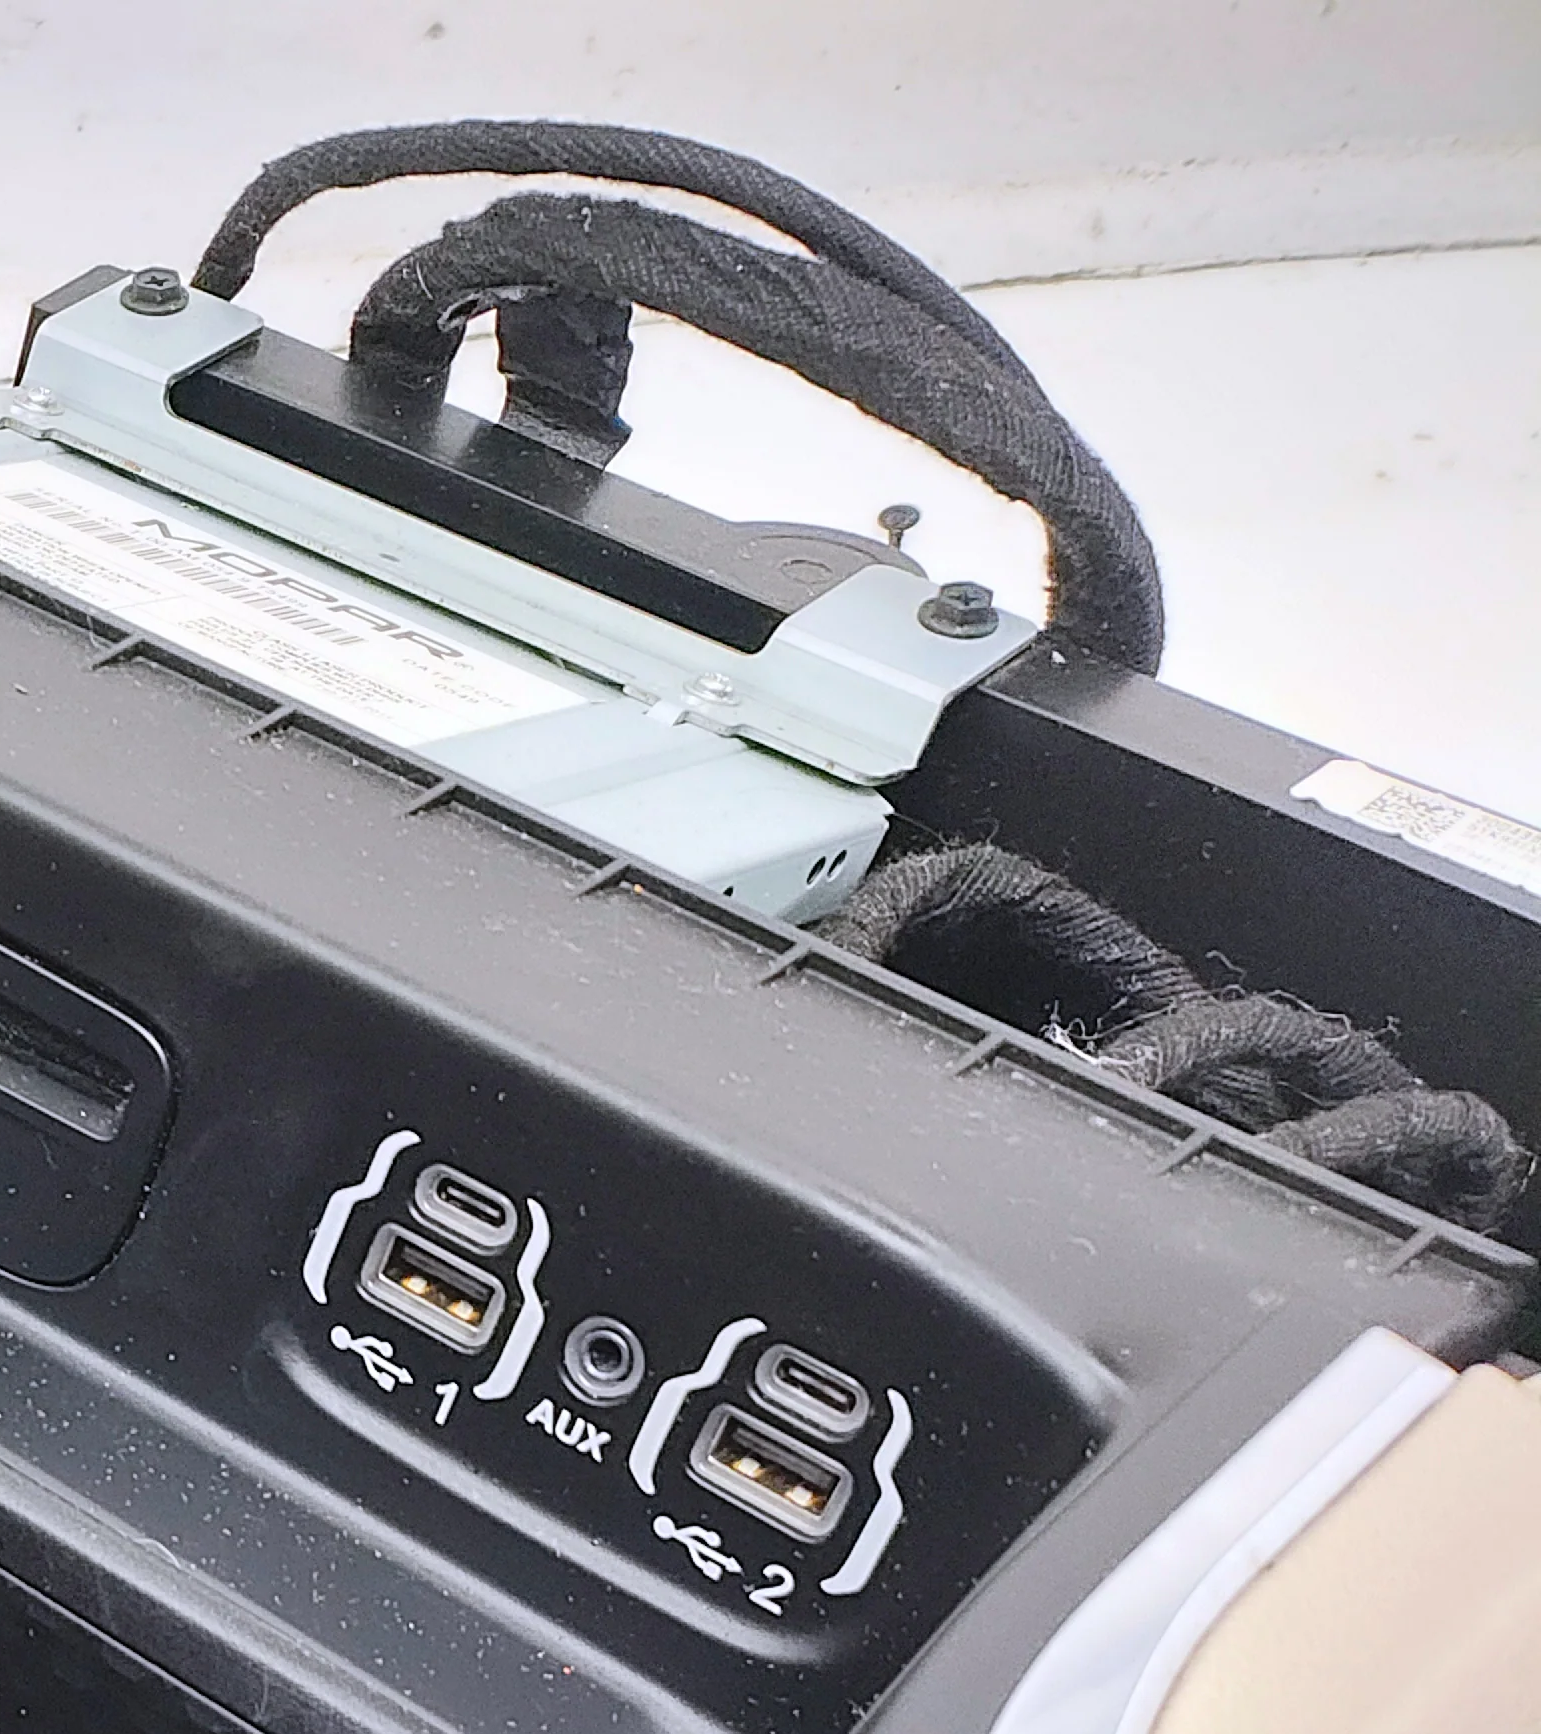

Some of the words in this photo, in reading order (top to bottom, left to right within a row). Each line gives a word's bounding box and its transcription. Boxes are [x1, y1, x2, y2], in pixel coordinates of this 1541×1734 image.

[130, 518, 466, 660] MOPAR
[433, 1380, 460, 1425] 1
[525, 1399, 611, 1463] AUX
[748, 1565, 795, 1616] 2
